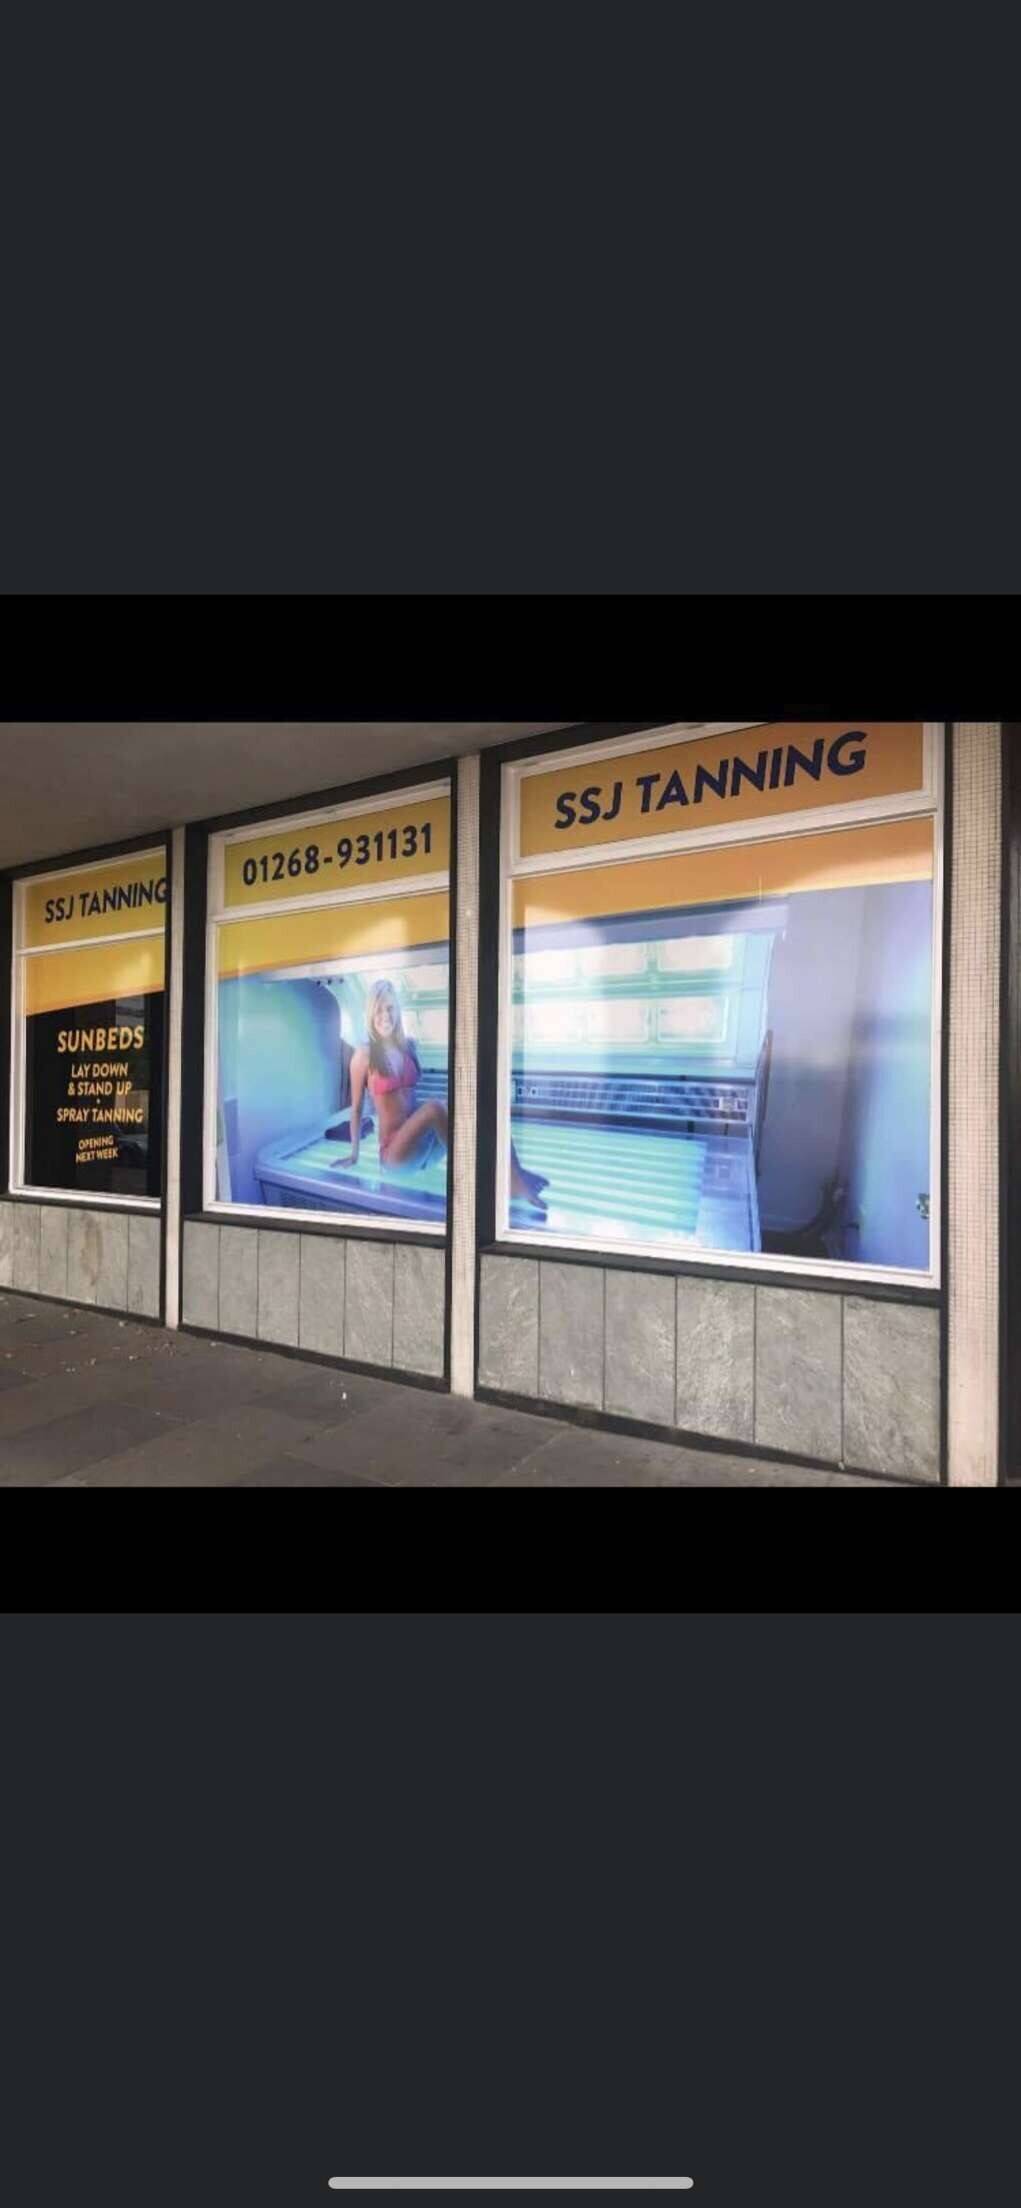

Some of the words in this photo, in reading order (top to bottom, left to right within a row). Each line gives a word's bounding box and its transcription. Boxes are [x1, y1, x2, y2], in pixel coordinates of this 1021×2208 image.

[554, 781, 623, 830] SSJ
[635, 730, 868, 815] TANNING
[243, 822, 432, 885] 01268-931131
[45, 895, 74, 923] SSJ
[57, 1024, 145, 1053] SUNBEDS
[71, 1063, 90, 1078] LAY
[92, 1062, 129, 1077] DOWN
[67, 1082, 75, 1096] &
[77, 1081, 113, 1096] STAND
[116, 1081, 133, 1096] UP
[56, 1108, 90, 1122] SPRAY
[92, 1108, 144, 1123] TANNING
[78, 1135, 114, 1150] OPENING
[75, 1150, 96, 1163] NEXT
[96, 1147, 119, 1160] WEEK
